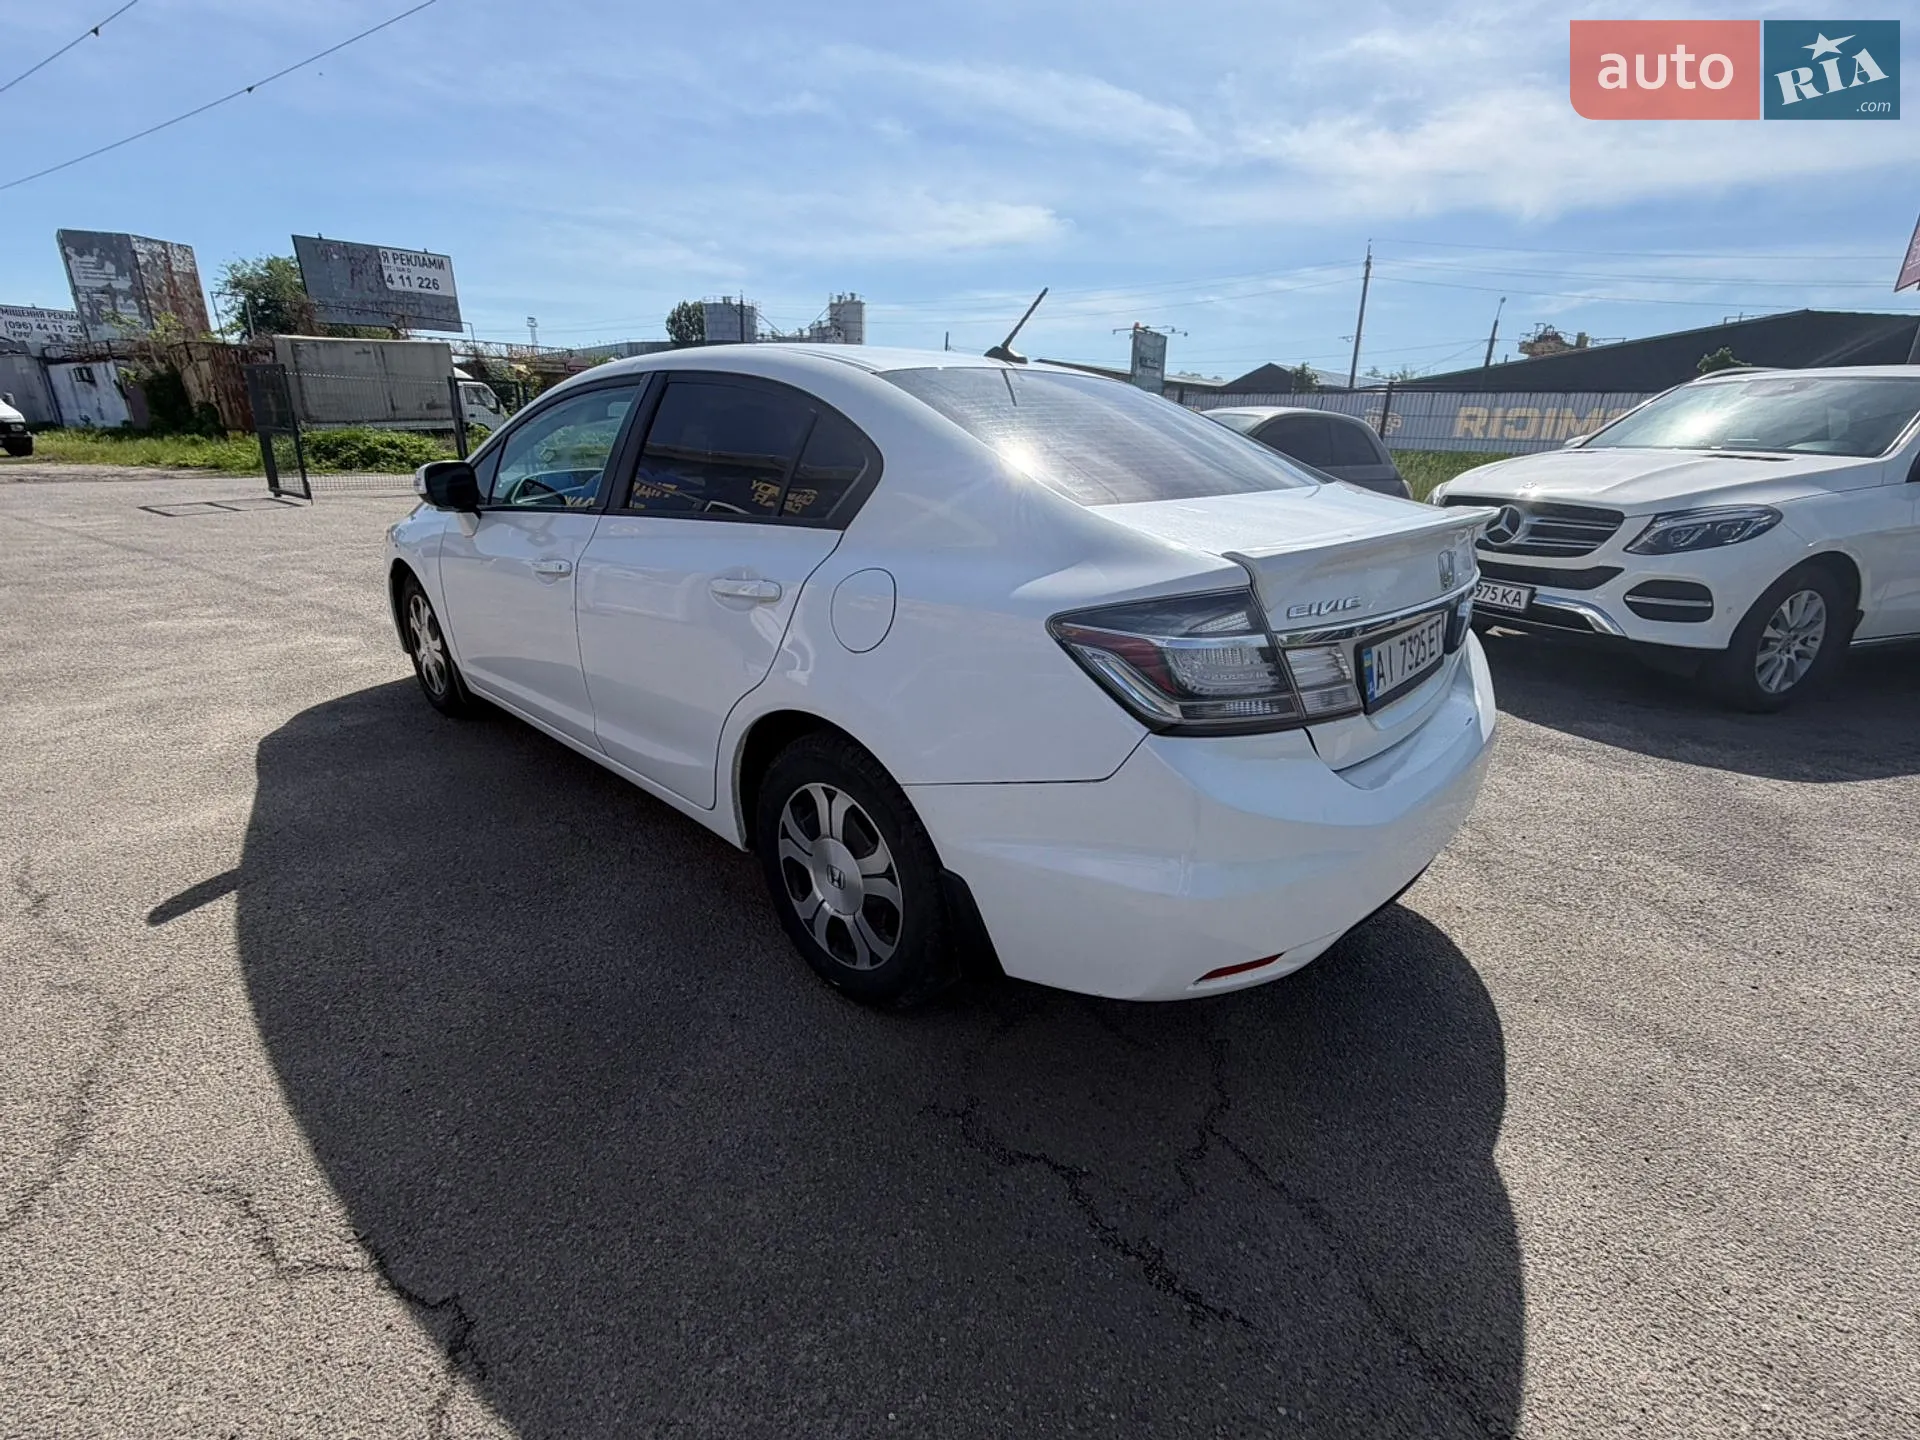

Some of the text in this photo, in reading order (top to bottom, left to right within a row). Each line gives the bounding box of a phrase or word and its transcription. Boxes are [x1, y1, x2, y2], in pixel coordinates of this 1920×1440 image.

[392, 252, 446, 271] РЕКЛАМИ
[398, 274, 412, 288] 11
[417, 276, 440, 291] 226
[36, 323, 50, 332] 44
[52, 324, 64, 333] 11
[1500, 588, 1523, 606] KA
[1287, 596, 1361, 619] CIVIC
[1376, 619, 1441, 690] AI 7325 ET
